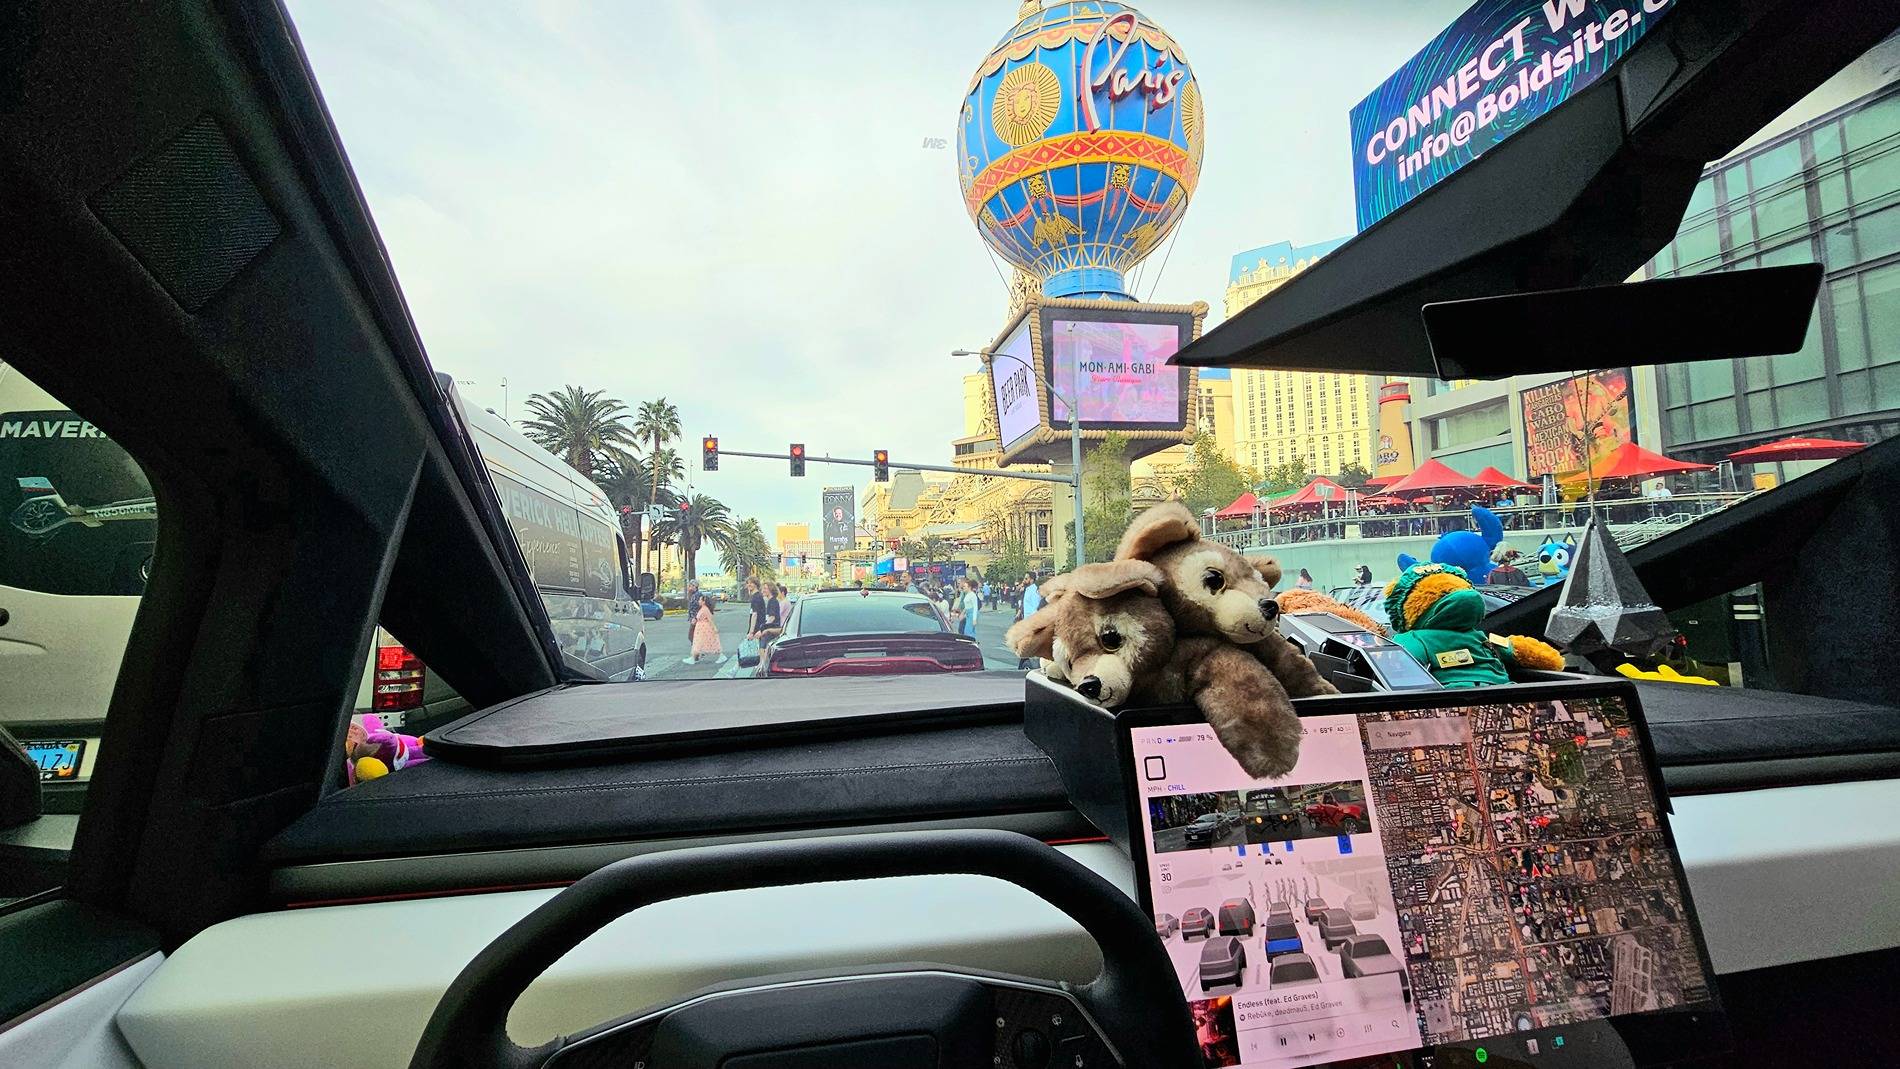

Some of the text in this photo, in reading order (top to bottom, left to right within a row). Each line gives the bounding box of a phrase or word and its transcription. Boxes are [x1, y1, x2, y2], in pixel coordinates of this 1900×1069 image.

[1081, 10, 1184, 134] Paris
[1366, 17, 1531, 166] CONNECT
[1531, 404, 1563, 421] CABO
[1537, 446, 1571, 470] ROCK
[1161, 872, 1172, 882] 30
[1238, 1001, 1263, 1009] Endless
